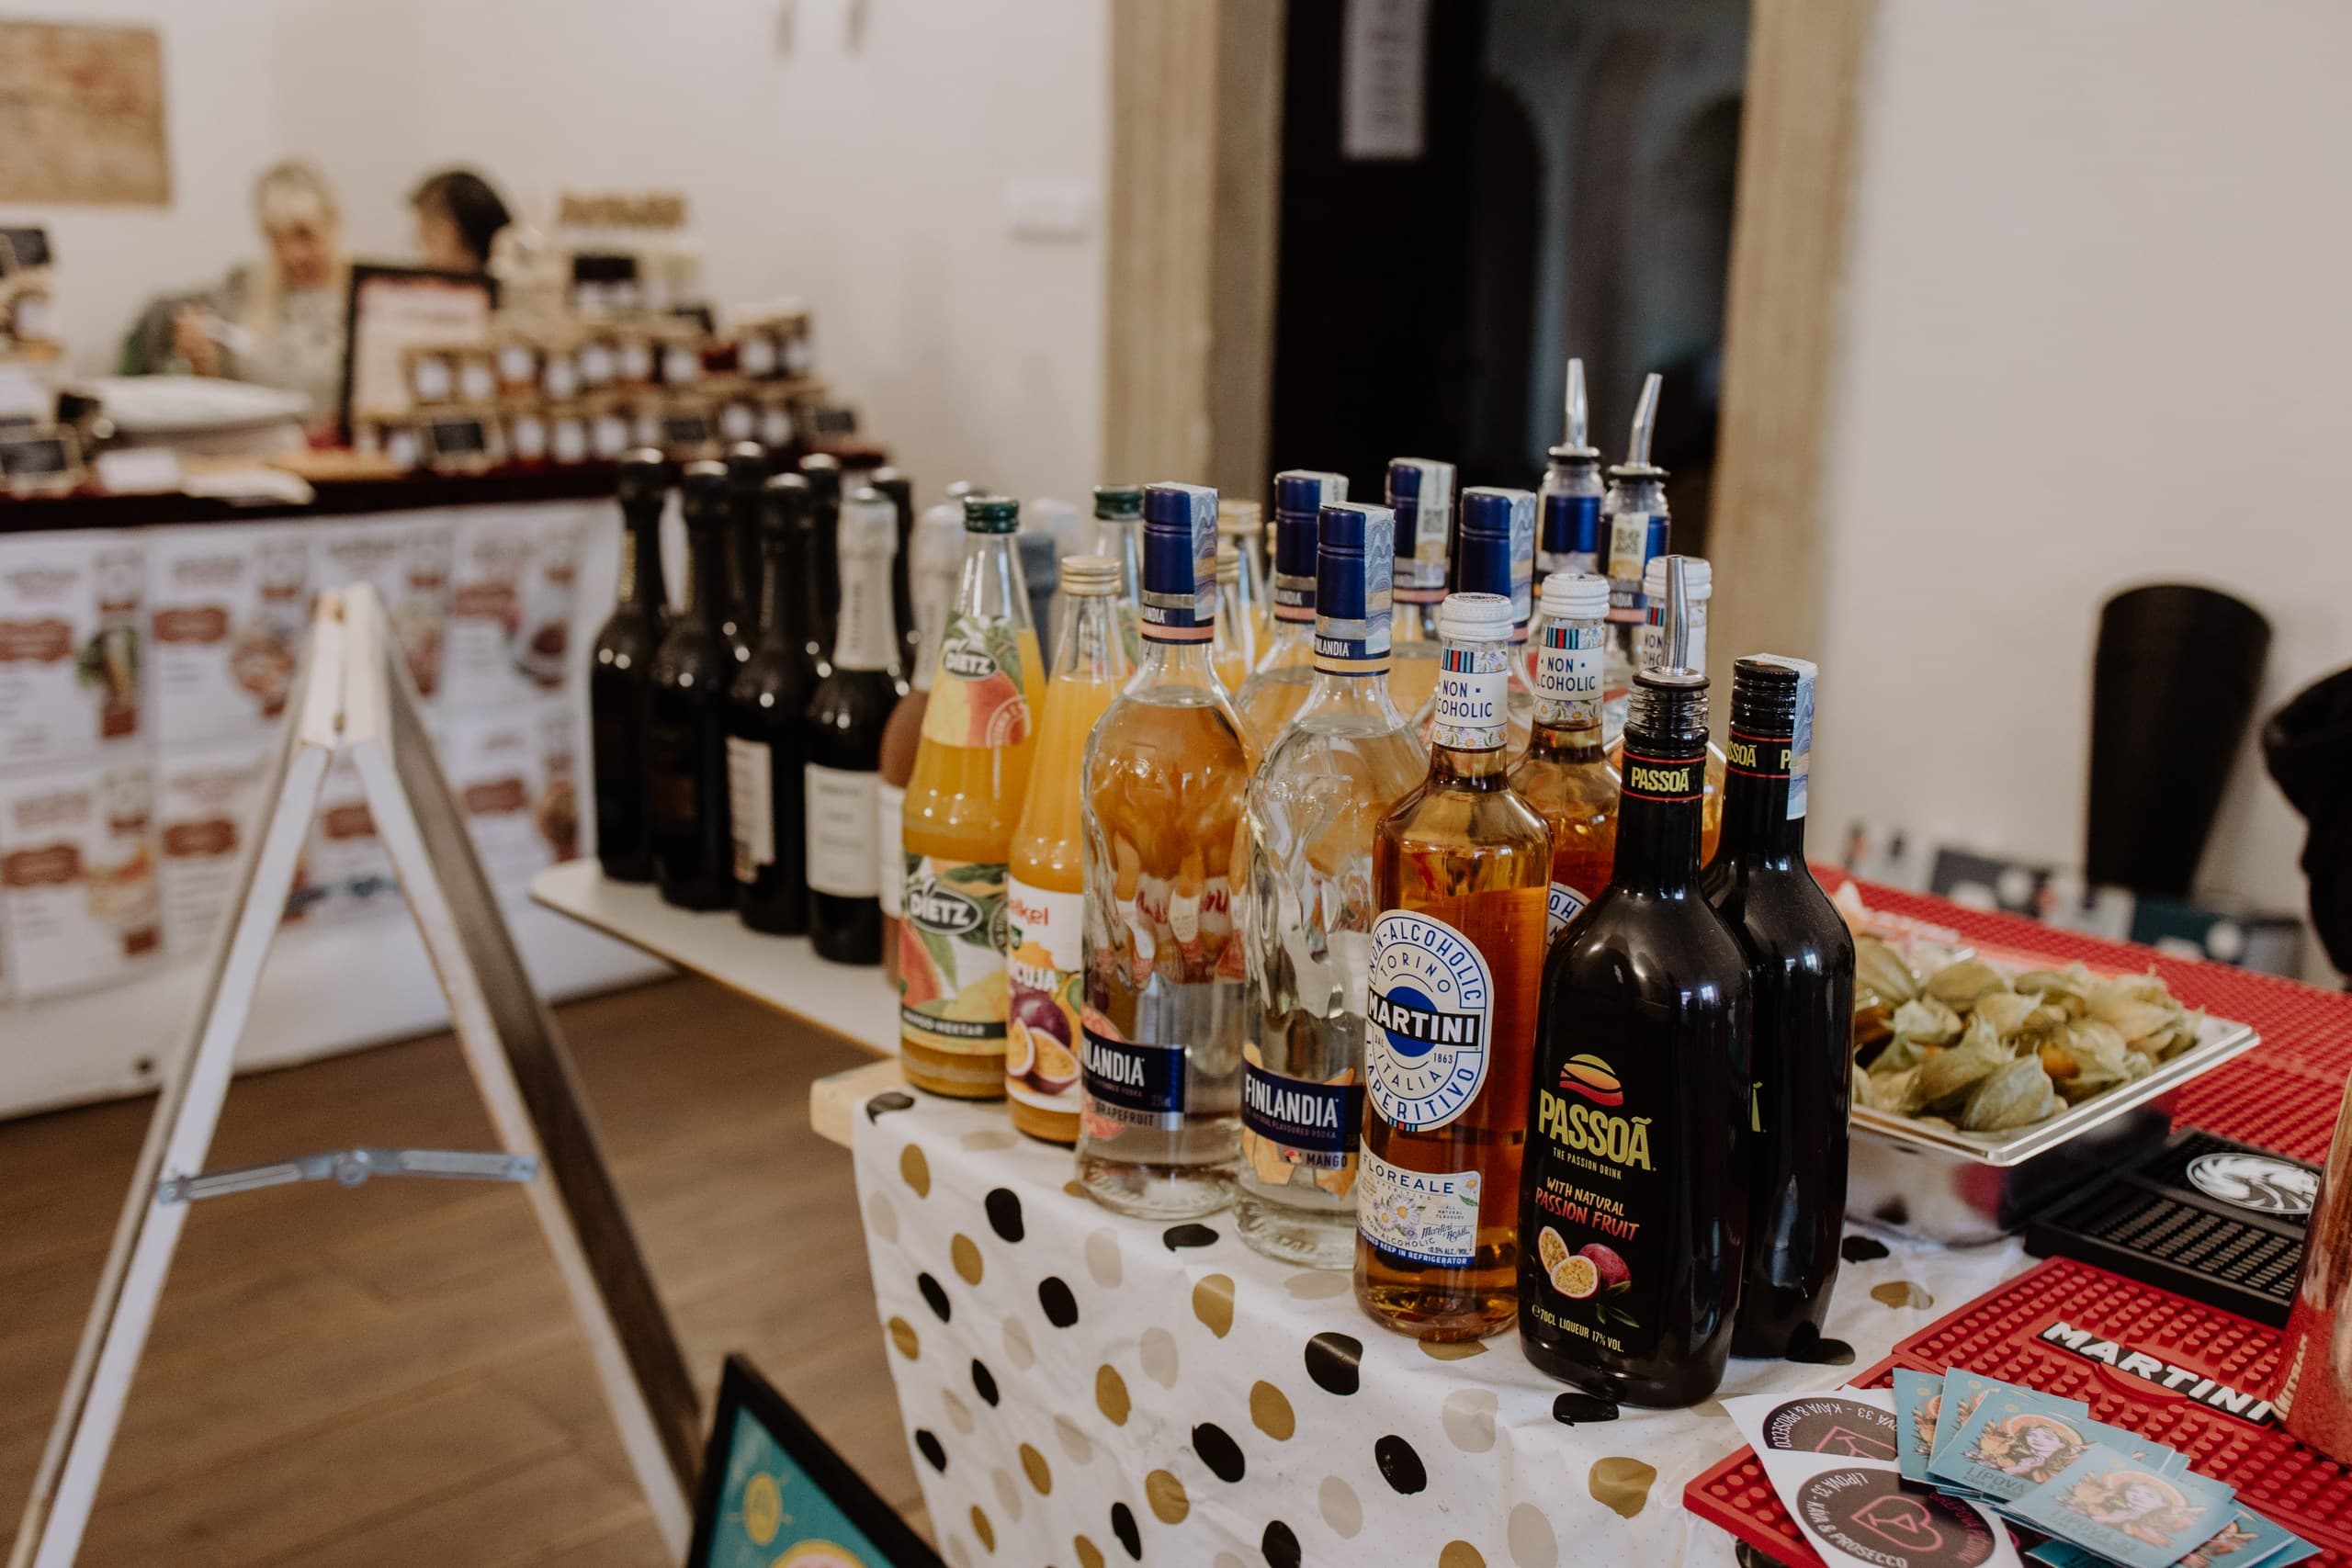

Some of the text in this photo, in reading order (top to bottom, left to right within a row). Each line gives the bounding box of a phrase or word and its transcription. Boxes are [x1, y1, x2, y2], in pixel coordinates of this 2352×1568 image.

[1537, 674, 1596, 691] COHOLIC
[1547, 656, 1574, 672] NON
[1442, 679, 1467, 698] NON
[1632, 766, 1690, 793] PASSOÃ
[909, 893, 970, 925] DIETZ
[1380, 952, 1452, 993] TORINO
[1369, 988, 1475, 1043] MARTINI
[1378, 1054, 1442, 1091] ITALIA
[1433, 1053, 1453, 1064] 1863
[1245, 1073, 1339, 1129] FINLANDIA
[1538, 1089, 1653, 1171] PASSOÃ
[1306, 1154, 1348, 1168] MANGO
[1363, 1154, 1454, 1194] FLOREALE
[1553, 1147, 1622, 1180] THE PASSION DRINK
[1535, 1187, 1640, 1241] PASSION FRUIT
[1546, 1177, 1624, 1217] WITH NATURAL
[1380, 1242, 1396, 1253] KEEP
[1408, 1250, 1467, 1265] REFRIGERATOR
[1559, 1317, 1589, 1338] LIQUEUR
[1591, 1330, 1606, 1346] 17%
[1607, 1337, 1624, 1353] VOL.
[2043, 1321, 2272, 1421] MARTINI
[1771, 1409, 1802, 1449] PROSECCO
[1829, 1531, 1908, 1568] PROSECCO
